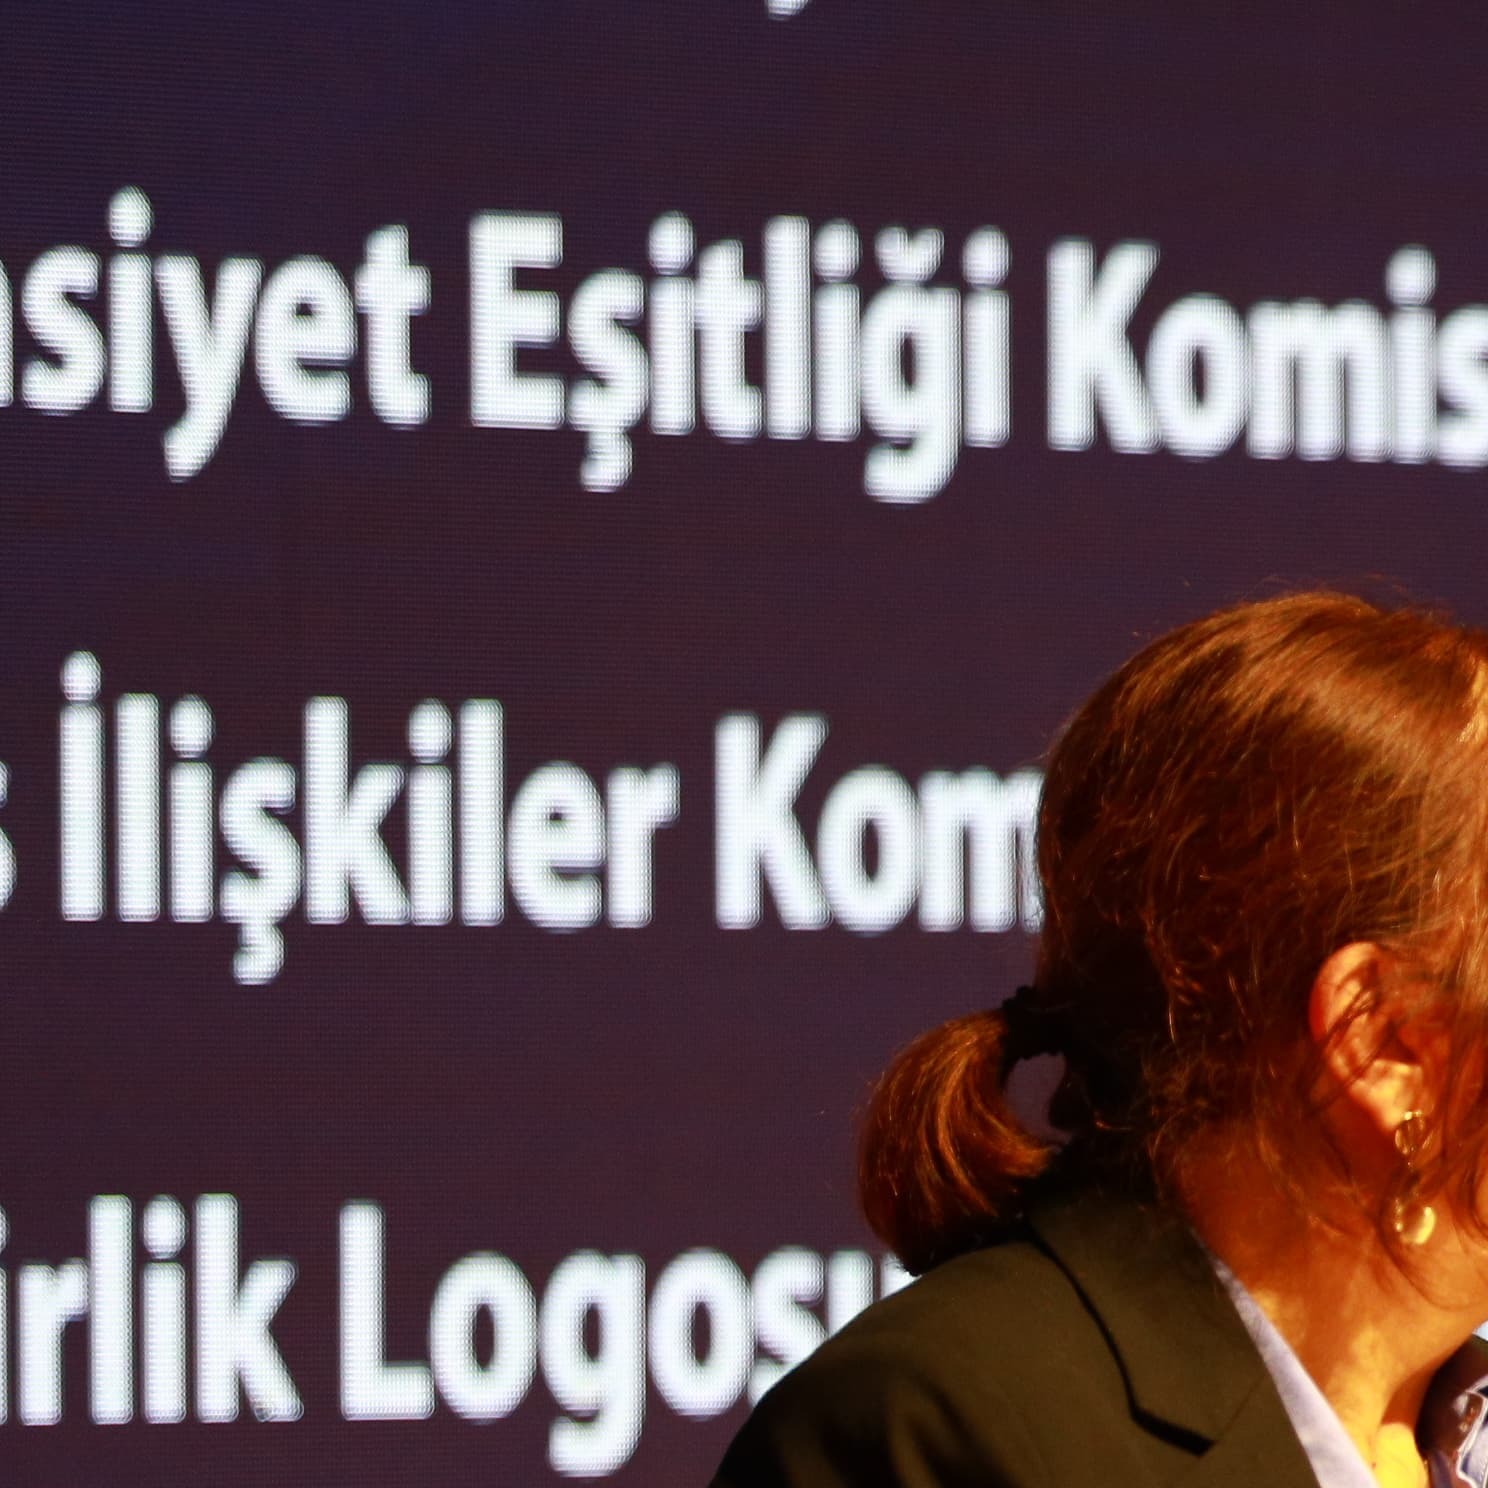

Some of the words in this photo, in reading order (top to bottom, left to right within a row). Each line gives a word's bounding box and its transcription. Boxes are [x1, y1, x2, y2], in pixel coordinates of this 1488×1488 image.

[0, 187, 432, 482] siyet
[469, 212, 1011, 504] Eşitliği
[59, 650, 681, 985] İlişkiler
[0, 1193, 304, 1426] rlik
[338, 1202, 922, 1479] Logos
